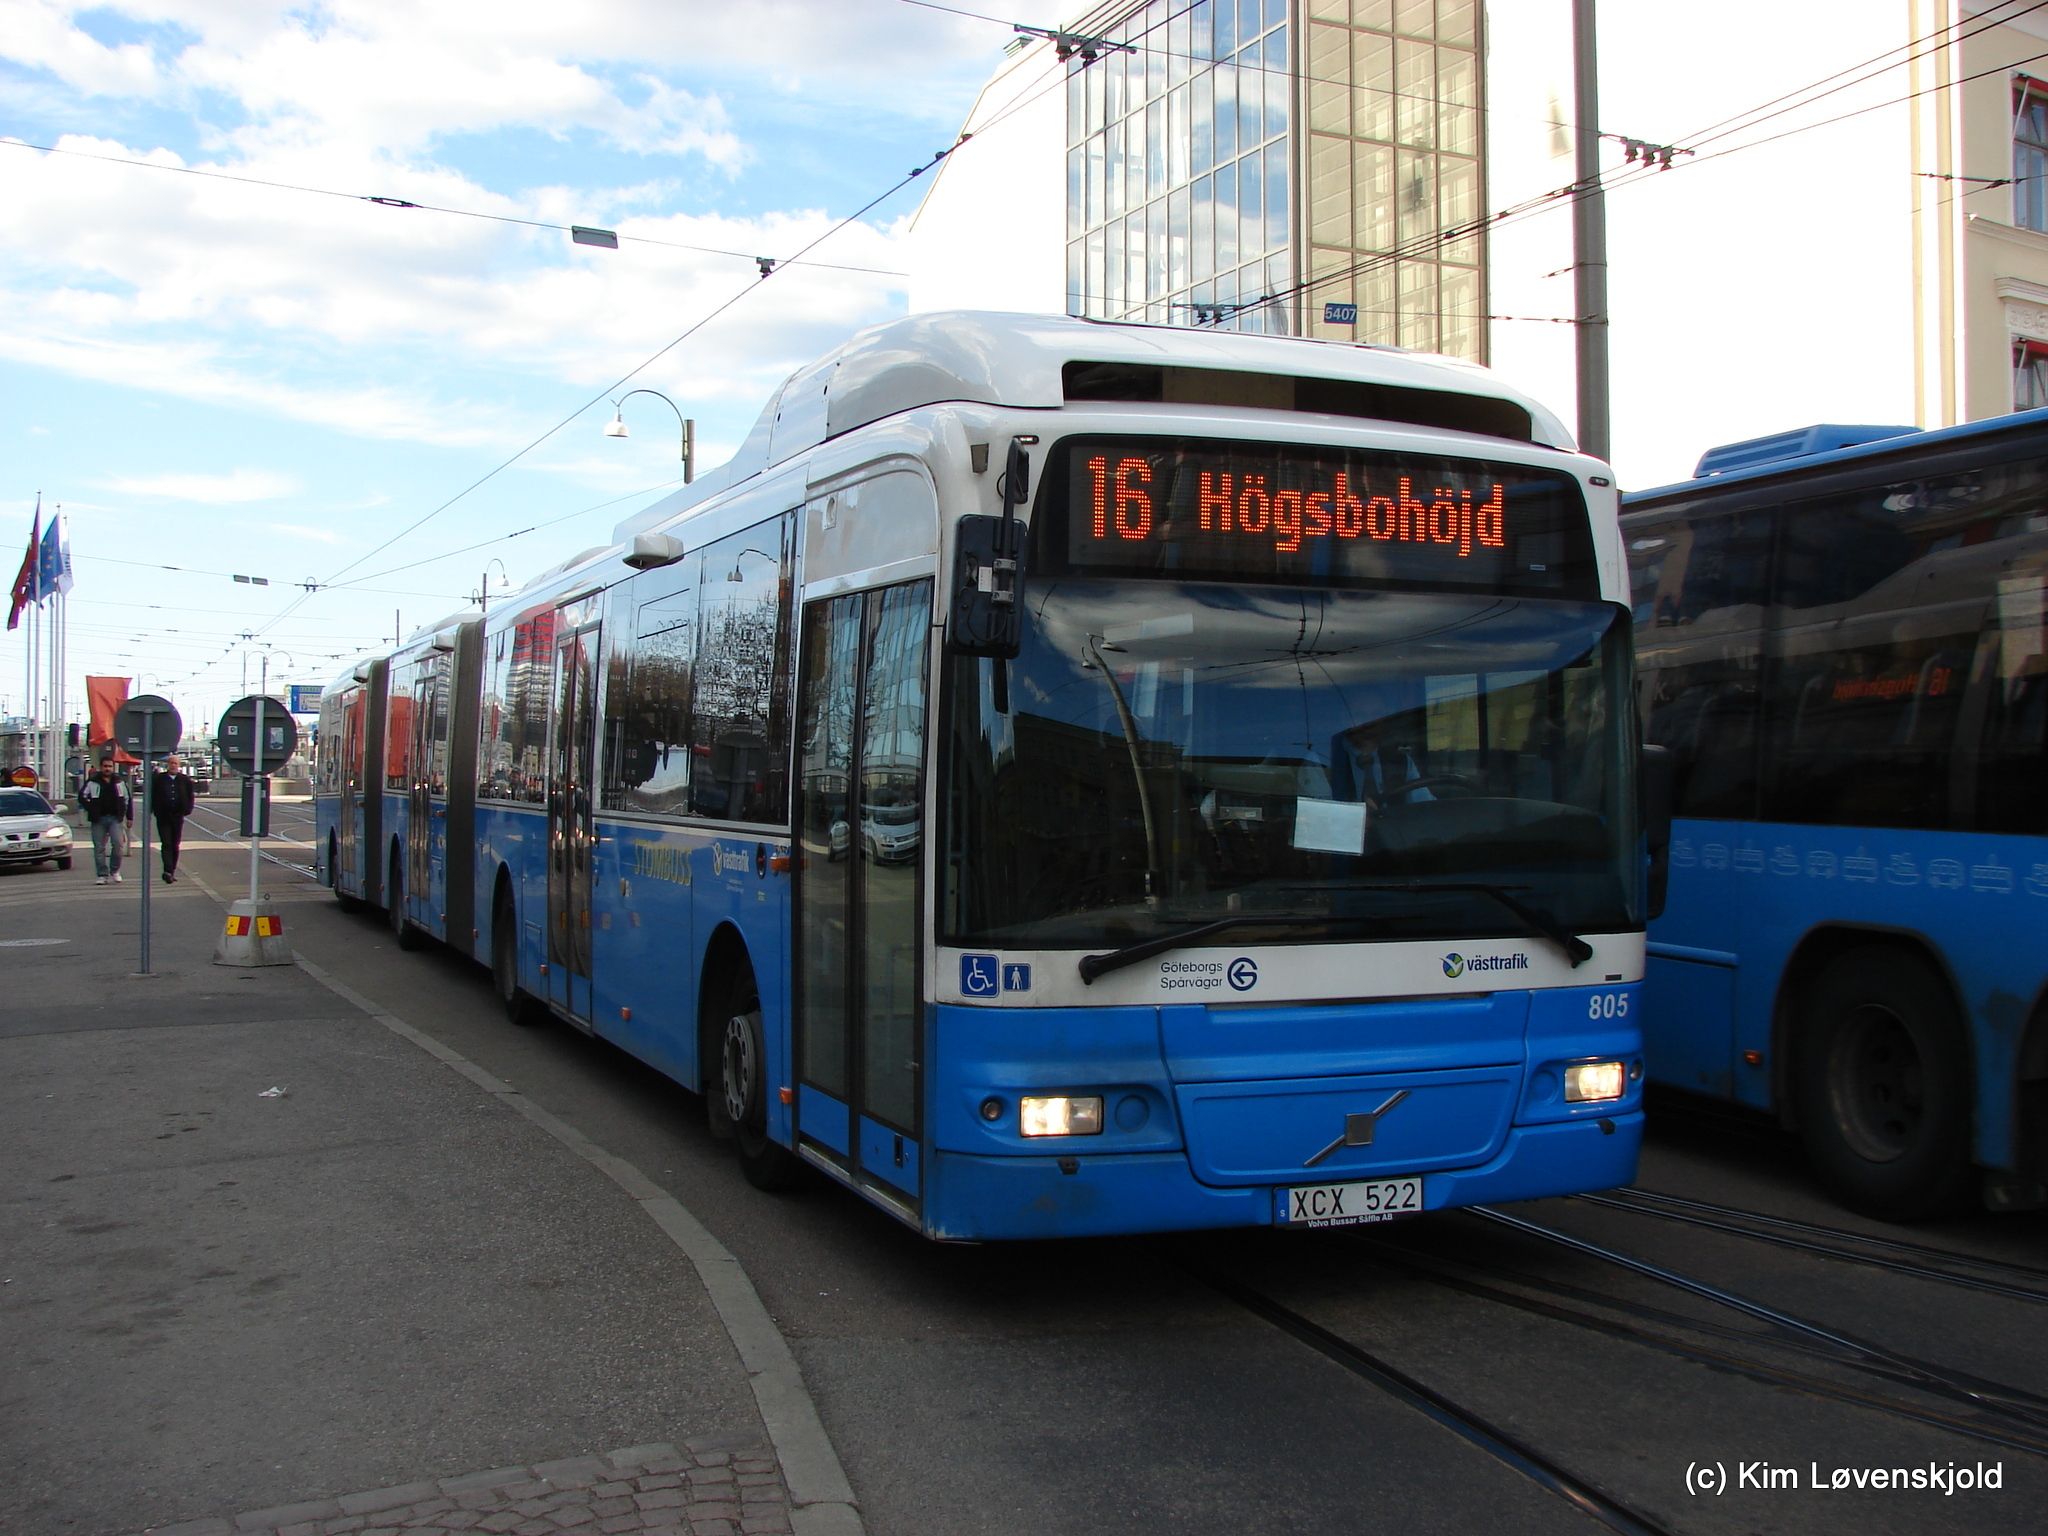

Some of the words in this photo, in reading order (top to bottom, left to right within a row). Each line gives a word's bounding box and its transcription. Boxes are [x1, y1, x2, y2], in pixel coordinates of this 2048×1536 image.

[1325, 306, 1356, 321] 5407
[1088, 456, 1152, 540] 16
[1200, 471, 1505, 557] Högsbohöjd
[1160, 961, 1223, 975] Göteborgs
[1467, 953, 1529, 971] västtrafik
[1588, 993, 1629, 1020] 805
[1294, 1187, 1344, 1218] XCX
[1366, 1182, 1416, 1211] 522
[1279, 1209, 1286, 1218] S
[1308, 1219, 1329, 1228] Volvo
[1330, 1217, 1357, 1226] Bussar
[1382, 1213, 1393, 1222] AB
